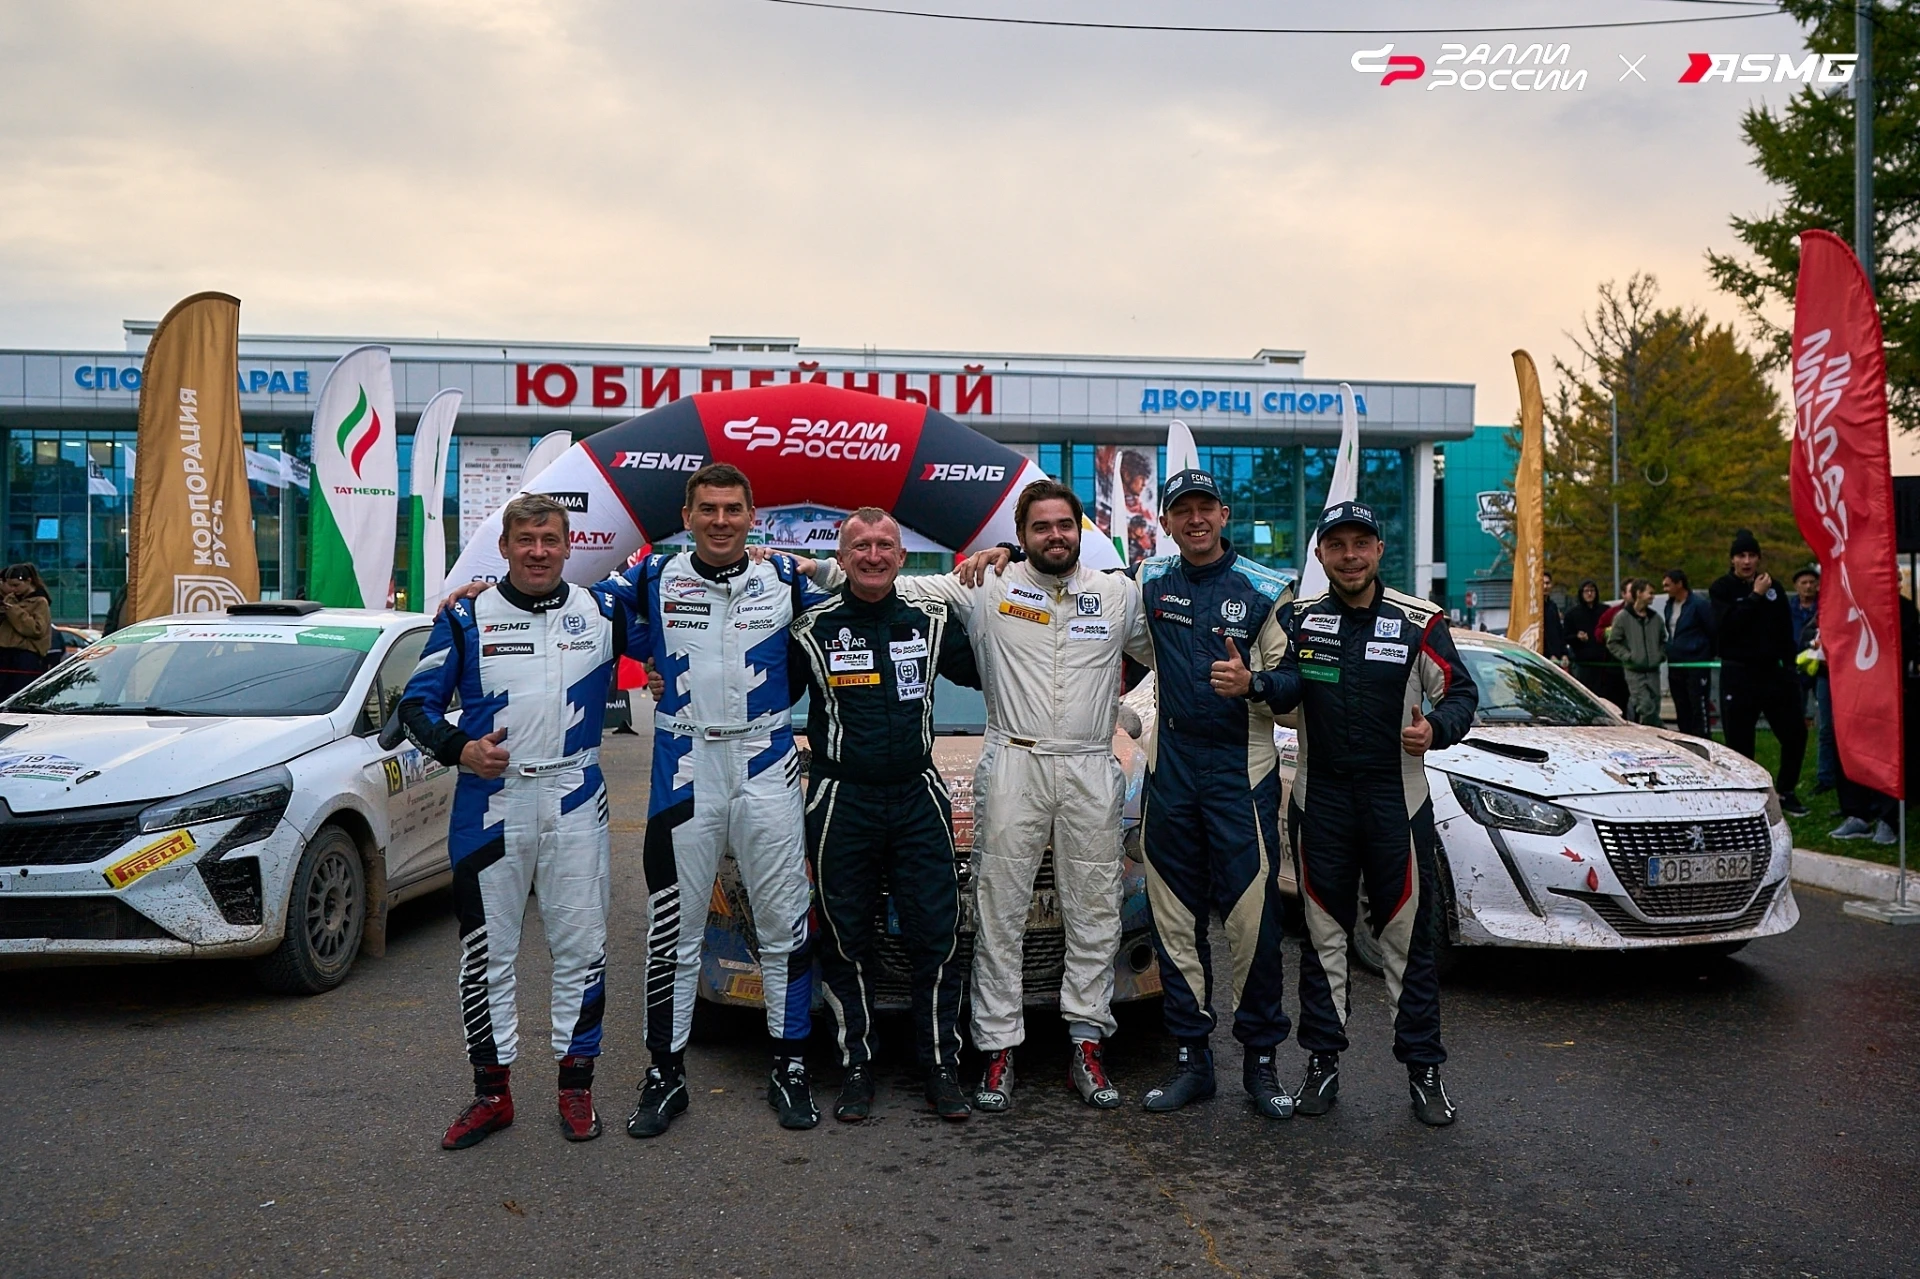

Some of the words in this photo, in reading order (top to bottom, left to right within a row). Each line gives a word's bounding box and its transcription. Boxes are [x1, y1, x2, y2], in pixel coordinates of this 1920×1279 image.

[74, 365, 142, 390] СПО
[1140, 388, 1252, 415] ДВОРЕЦ
[790, 418, 888, 441] РАЛЛИ
[779, 438, 900, 462] РОССИИ
[619, 451, 704, 472] ASMG
[179, 387, 213, 565] КОРПОРАЦИЯ
[931, 463, 1006, 482] ASMG
[333, 486, 396, 496] ТАТНЕФТЬ
[211, 499, 230, 568] РУСЬ
[1016, 589, 1045, 601] ASMG
[675, 604, 709, 614] YOKOHAMA
[925, 604, 944, 614] OMP
[1008, 605, 1042, 621] PIRELLI
[1162, 611, 1193, 626] YOKOHAMA
[491, 622, 531, 633] ASMG
[672, 620, 709, 630] ASMG
[189, 631, 283, 640] ТАТНЕФТЬ
[1308, 635, 1341, 647] YOKOHAMA
[496, 644, 532, 653] YOKOHAMA
[839, 653, 869, 661] ASMG
[836, 675, 871, 685] PIRELLI
[672, 722, 696, 733] HRX
[24, 755, 46, 763] 19
[384, 761, 401, 792] 19
[113, 835, 188, 883] PIRELLI
